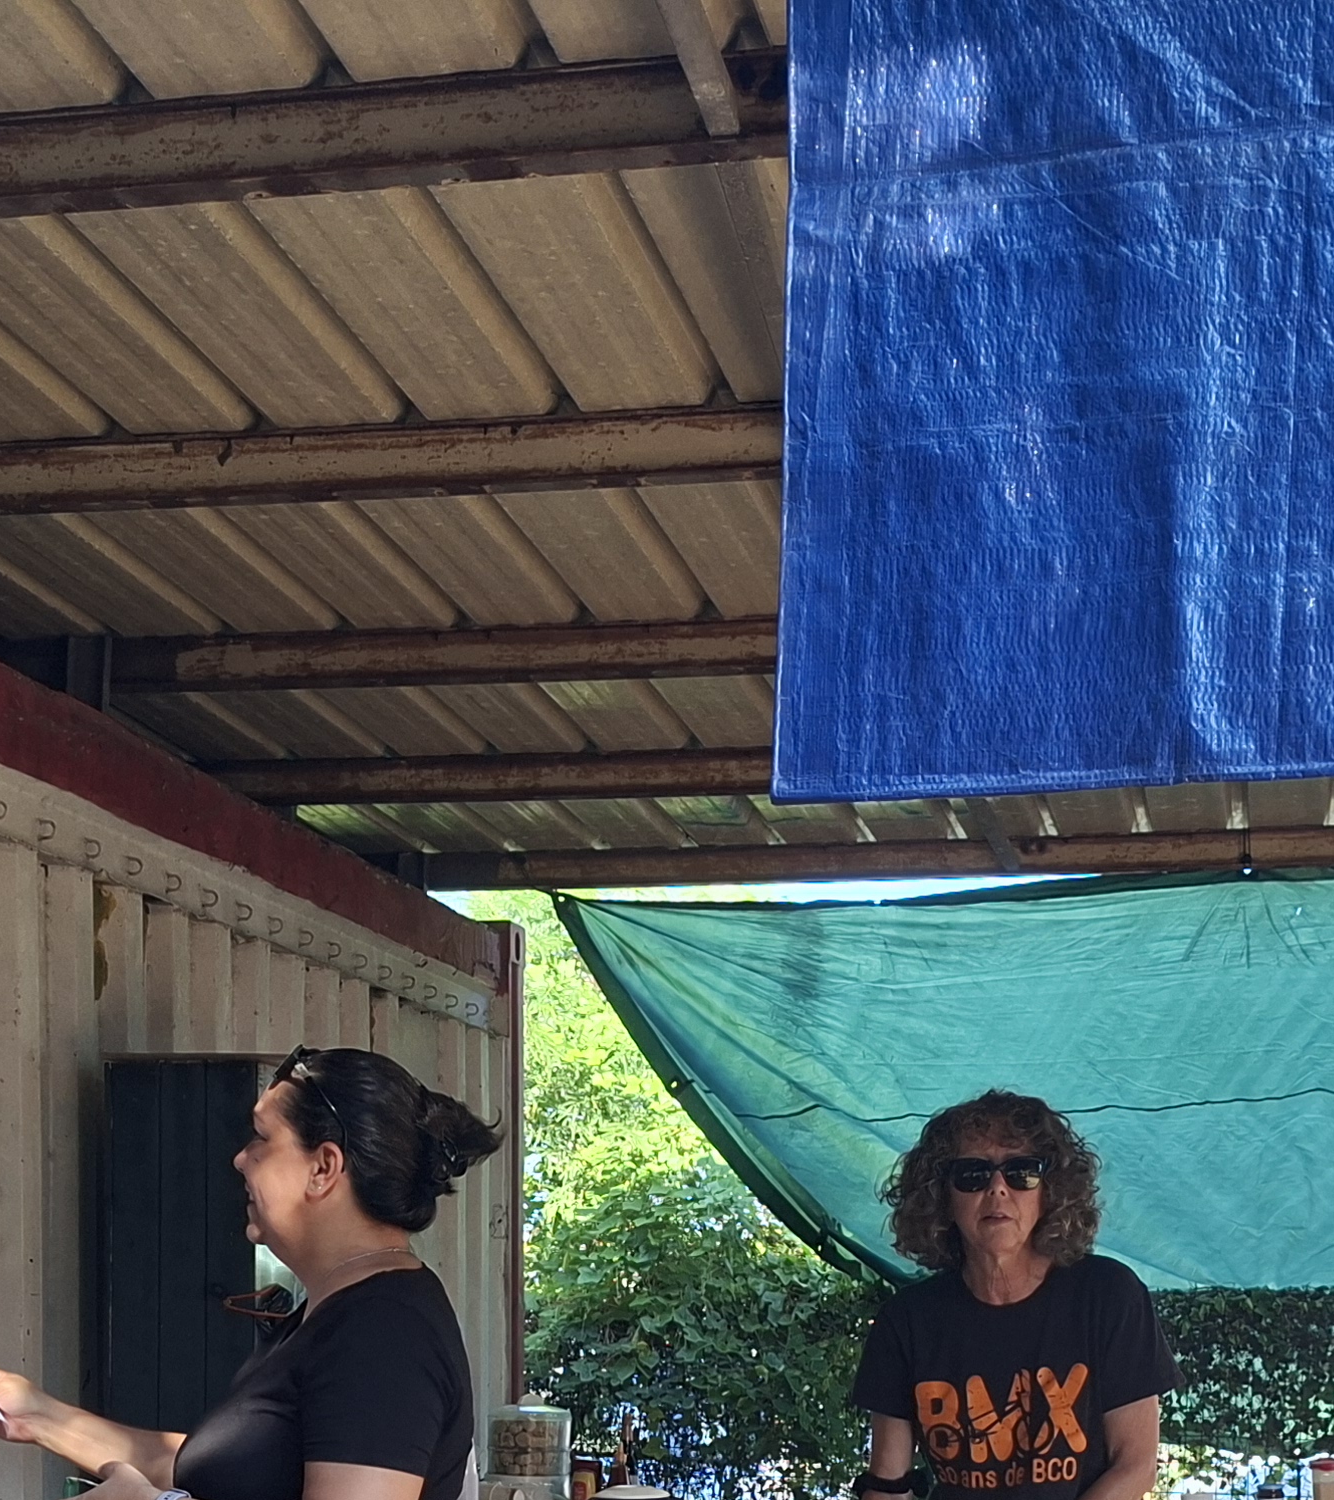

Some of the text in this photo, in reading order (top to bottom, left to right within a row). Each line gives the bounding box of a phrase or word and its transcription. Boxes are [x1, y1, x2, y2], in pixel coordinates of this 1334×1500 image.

[915, 1363, 1089, 1464] BMX
[961, 1469, 998, 1489] ans
[1005, 1462, 1025, 1487] de
[1032, 1457, 1077, 1483] BCO
